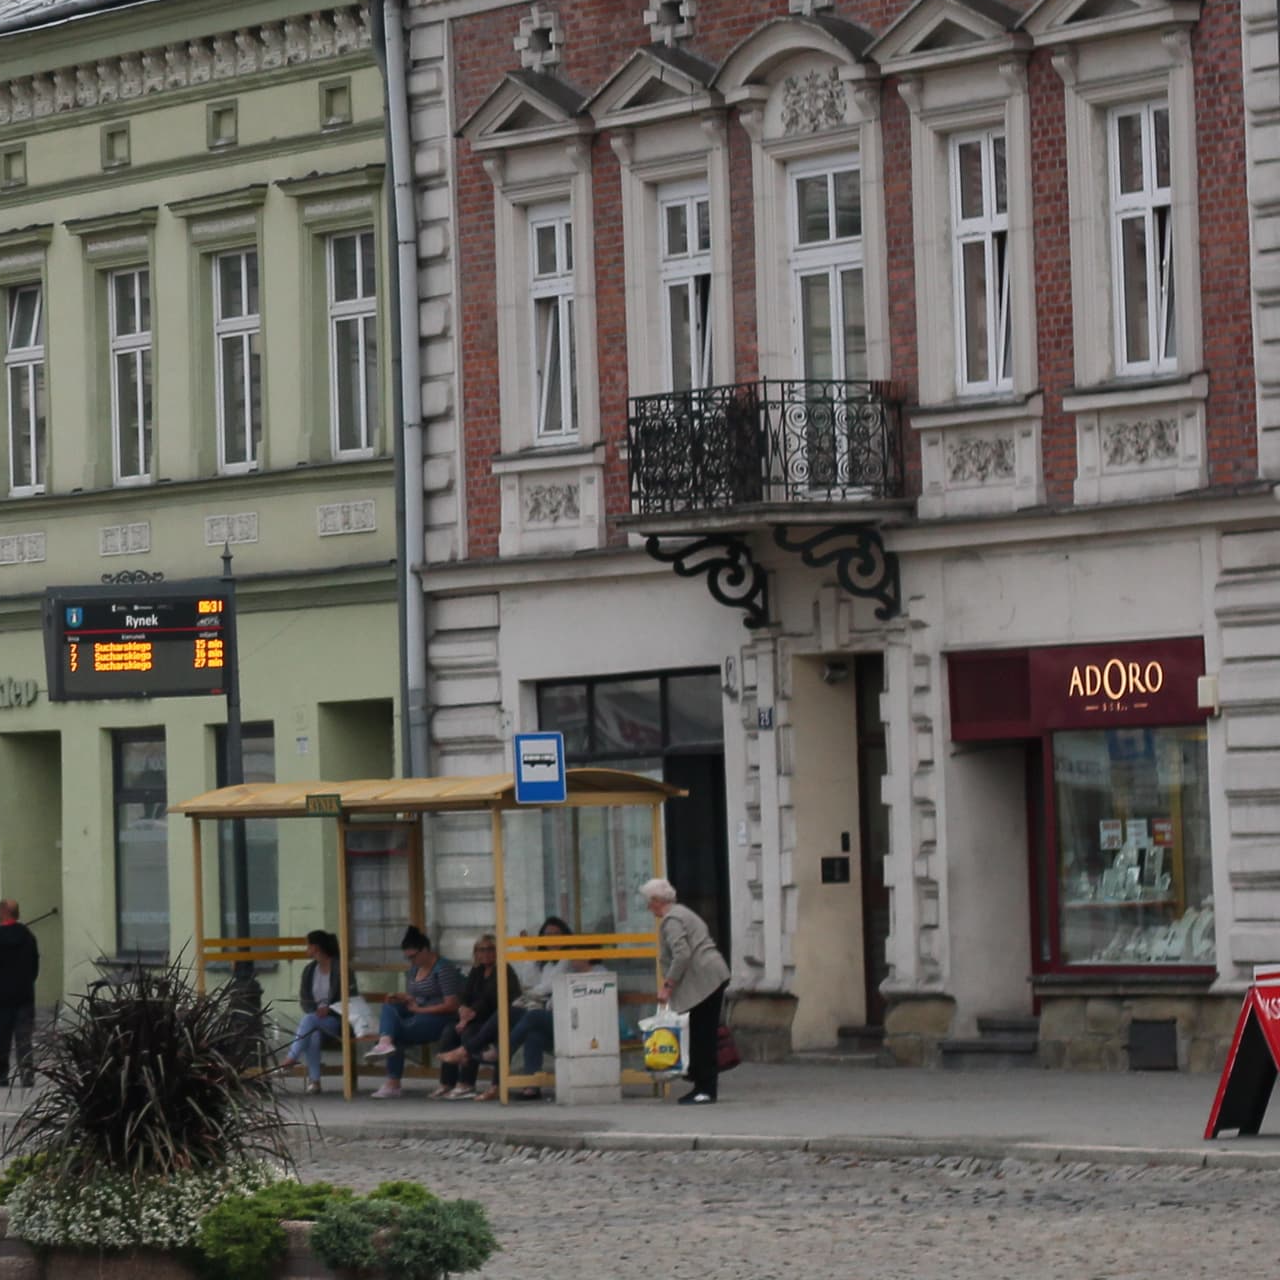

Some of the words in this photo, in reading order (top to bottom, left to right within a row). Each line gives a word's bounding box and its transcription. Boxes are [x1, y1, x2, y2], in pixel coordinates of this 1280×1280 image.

[125, 613, 159, 629] Rynek
[70, 643, 78, 653] 7
[70, 652, 78, 662] 7
[70, 662, 78, 672] 7
[1068, 658, 1164, 700] ADORO
